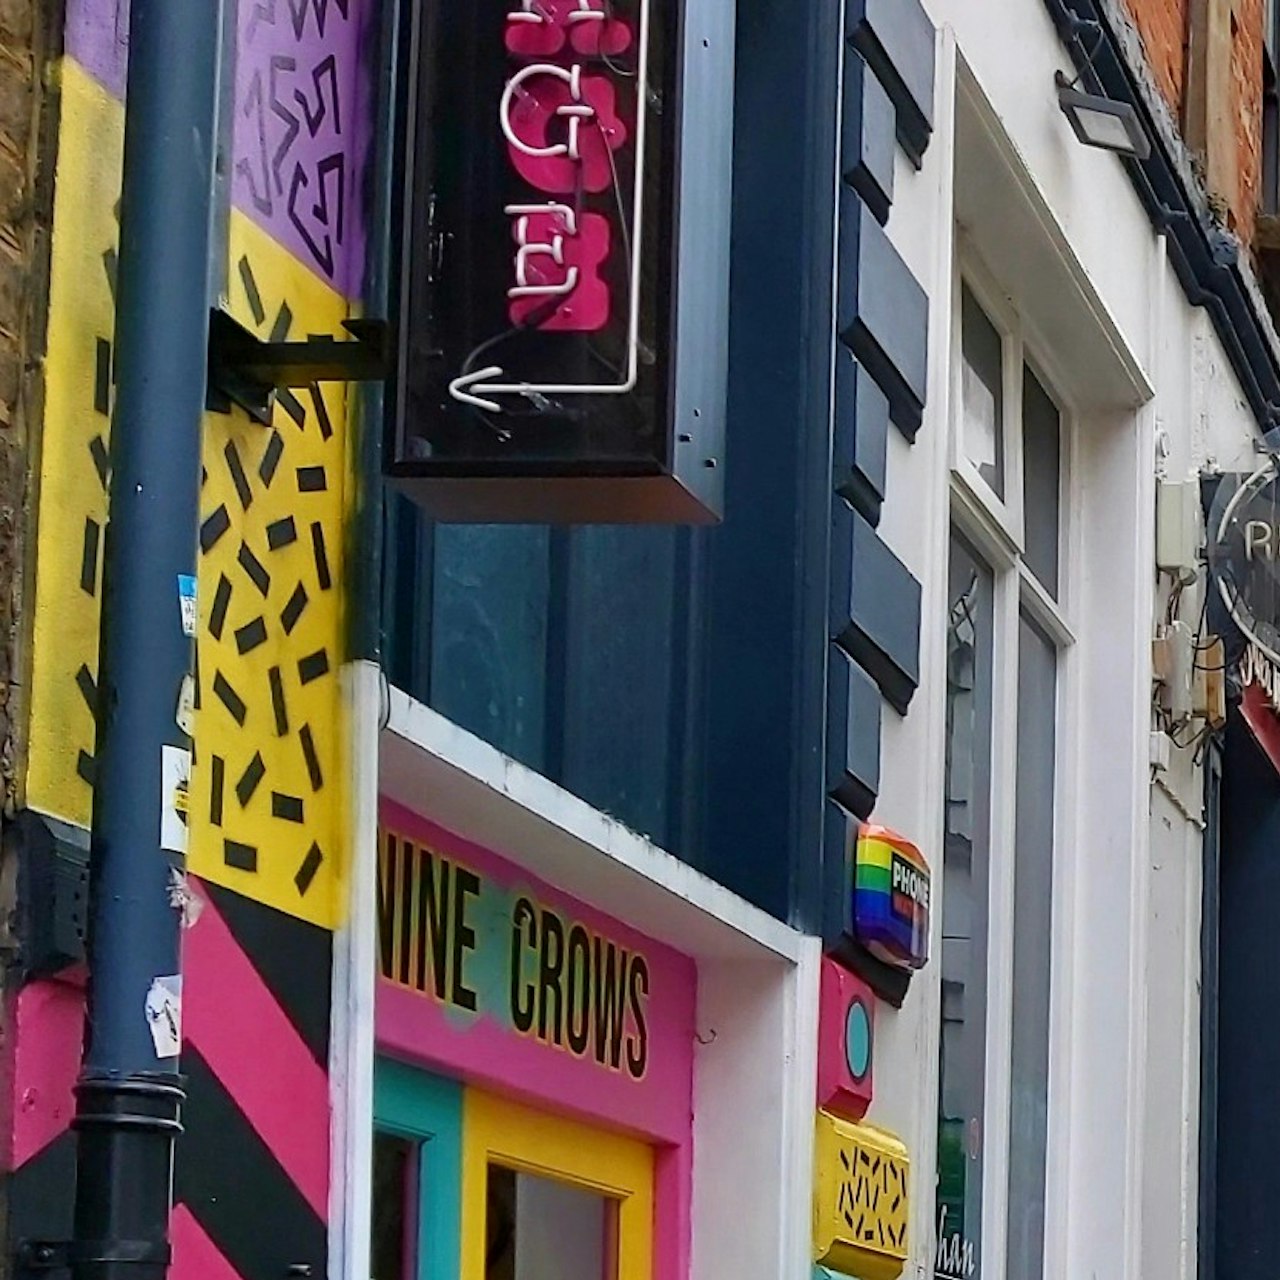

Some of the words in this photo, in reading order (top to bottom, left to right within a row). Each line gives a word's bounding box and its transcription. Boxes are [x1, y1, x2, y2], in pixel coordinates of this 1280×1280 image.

[377, 825, 481, 1013] NINE
[510, 896, 650, 1079] CROWS
[892, 860, 929, 909] PHONE
